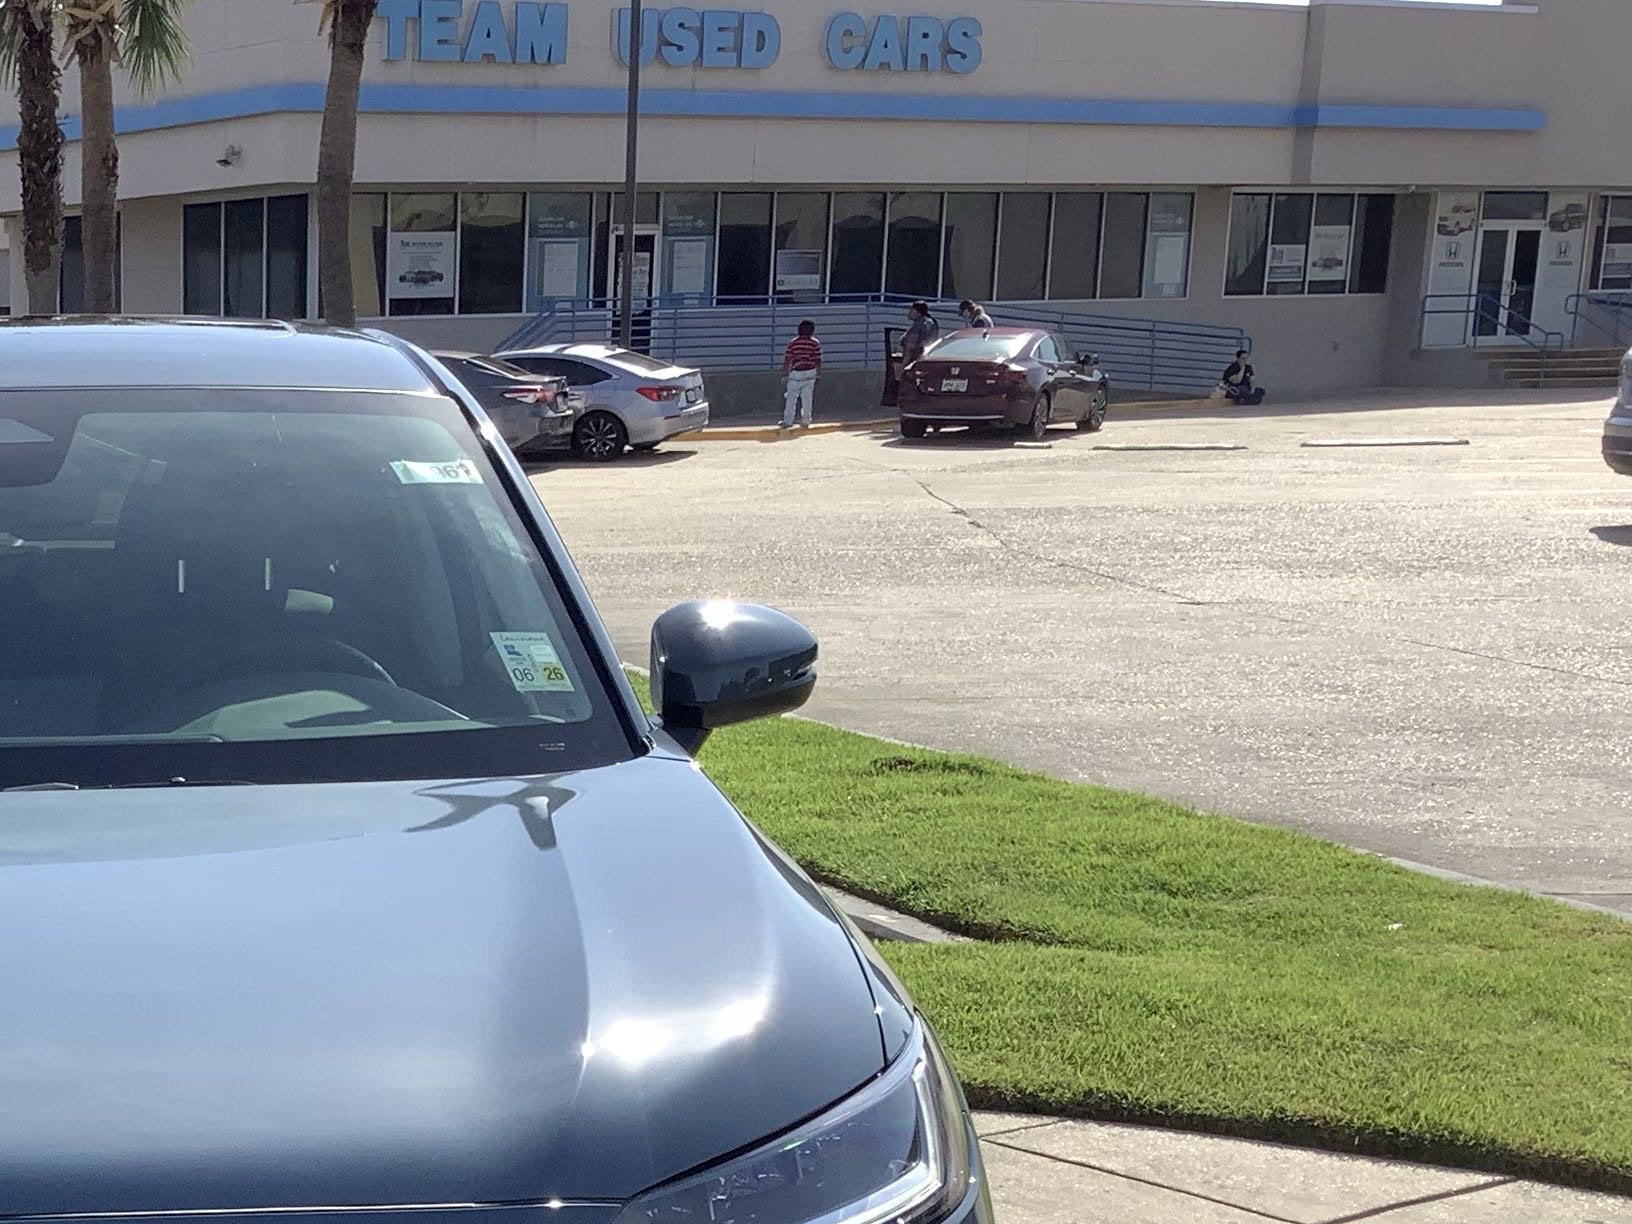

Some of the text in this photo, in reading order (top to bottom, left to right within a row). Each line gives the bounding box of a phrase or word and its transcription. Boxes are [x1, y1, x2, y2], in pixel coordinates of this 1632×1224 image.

[376, 0, 982, 74] TEAM USED CARS
[512, 667, 535, 682] 06
[543, 667, 564, 681] 26
